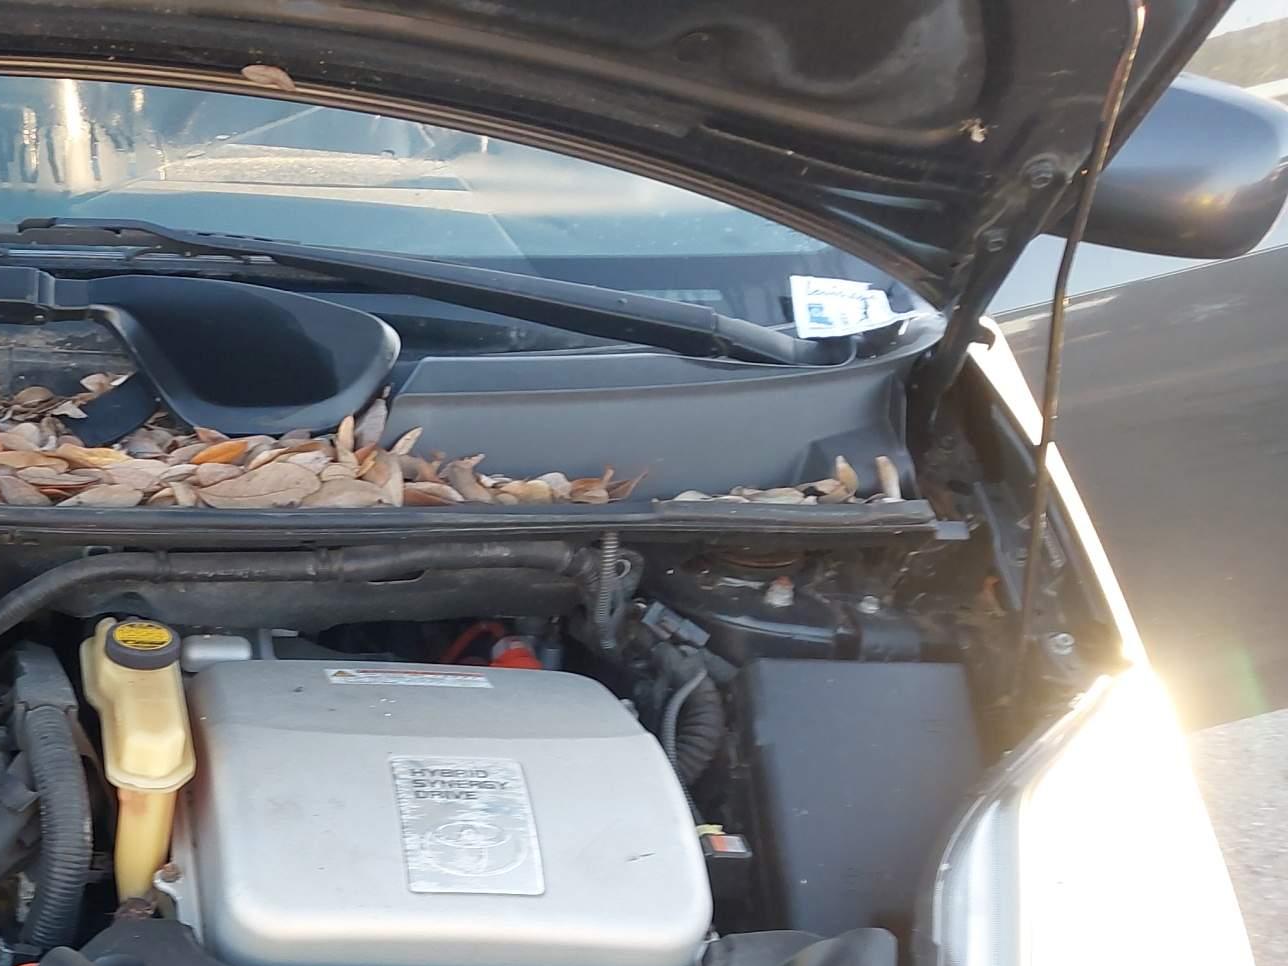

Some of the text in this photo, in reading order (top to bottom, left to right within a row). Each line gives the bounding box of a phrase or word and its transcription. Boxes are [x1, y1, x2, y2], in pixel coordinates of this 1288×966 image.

[410, 768, 489, 779] HYBRID
[412, 778, 509, 790] SYNERGY
[414, 790, 478, 800] DRIVE
